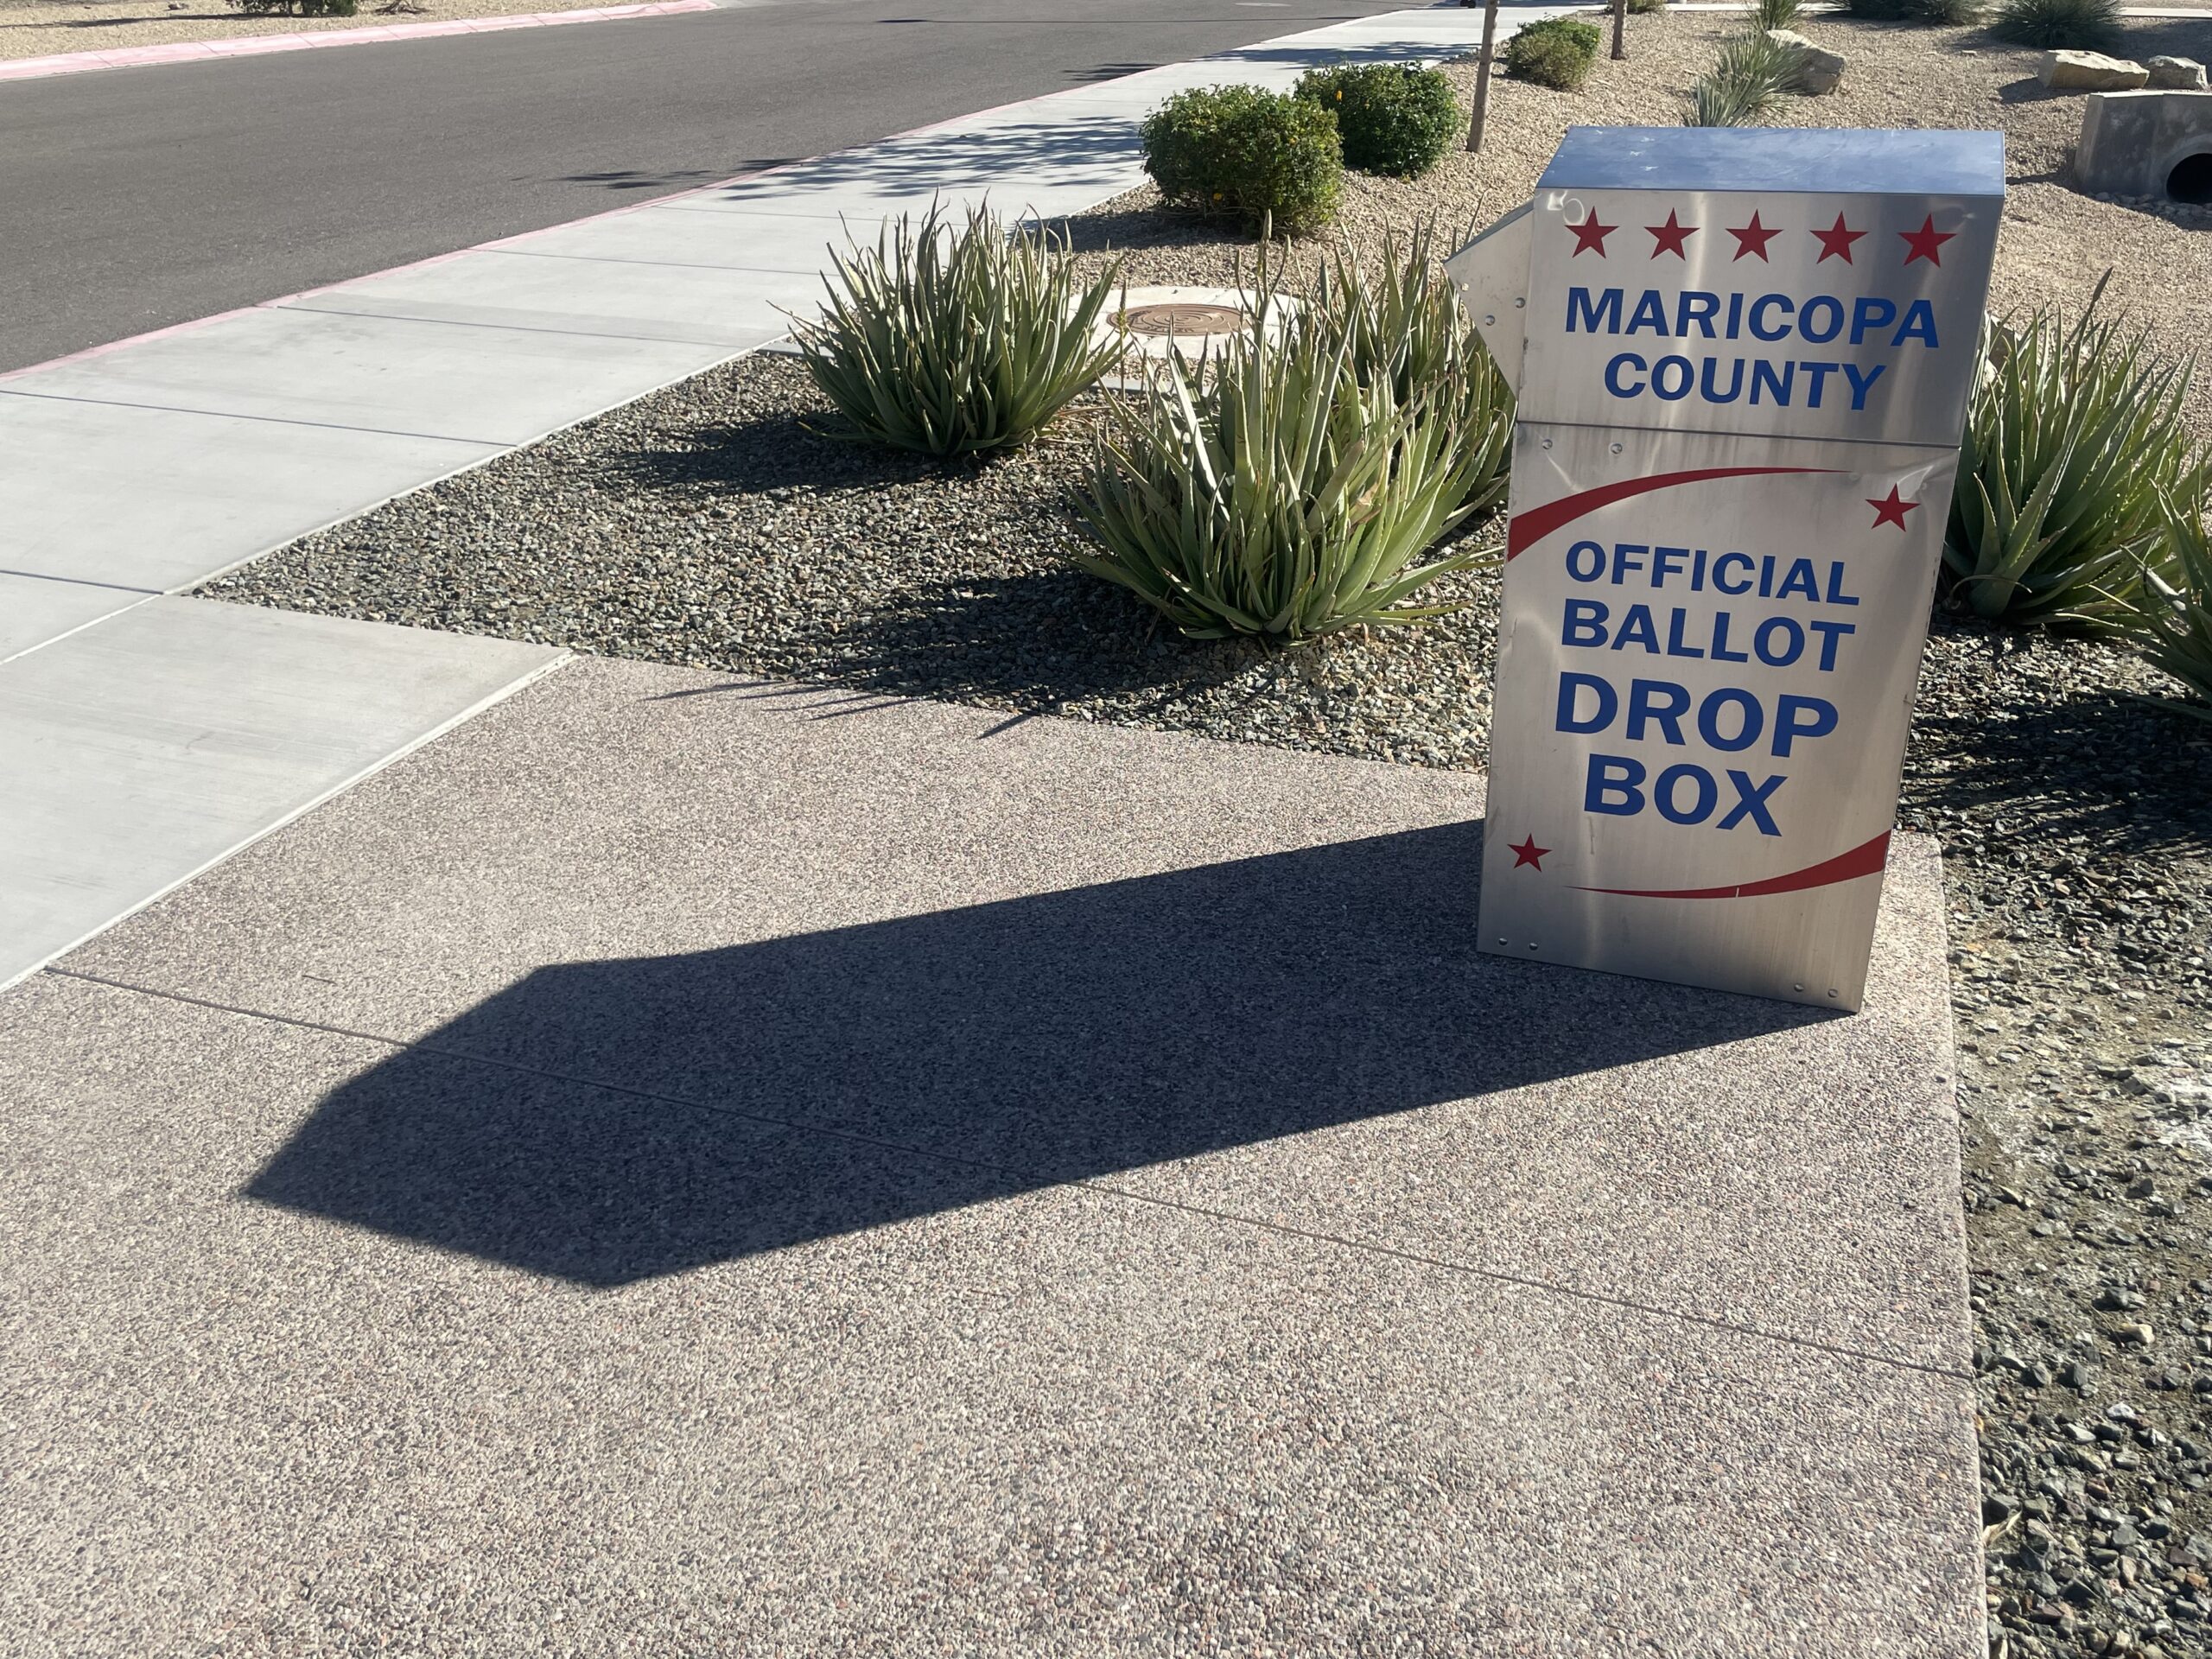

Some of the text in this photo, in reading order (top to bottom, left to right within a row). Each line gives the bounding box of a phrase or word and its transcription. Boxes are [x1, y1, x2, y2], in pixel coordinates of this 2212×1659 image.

[1566, 287, 1940, 349] MARICOPA
[1605, 353, 1887, 410] COUNTY
[1566, 541, 1859, 606] OFFICIAL
[1561, 599, 1856, 671] BALLOT
[1555, 671, 1839, 758] DROP
[1584, 754, 1788, 836] BOX
